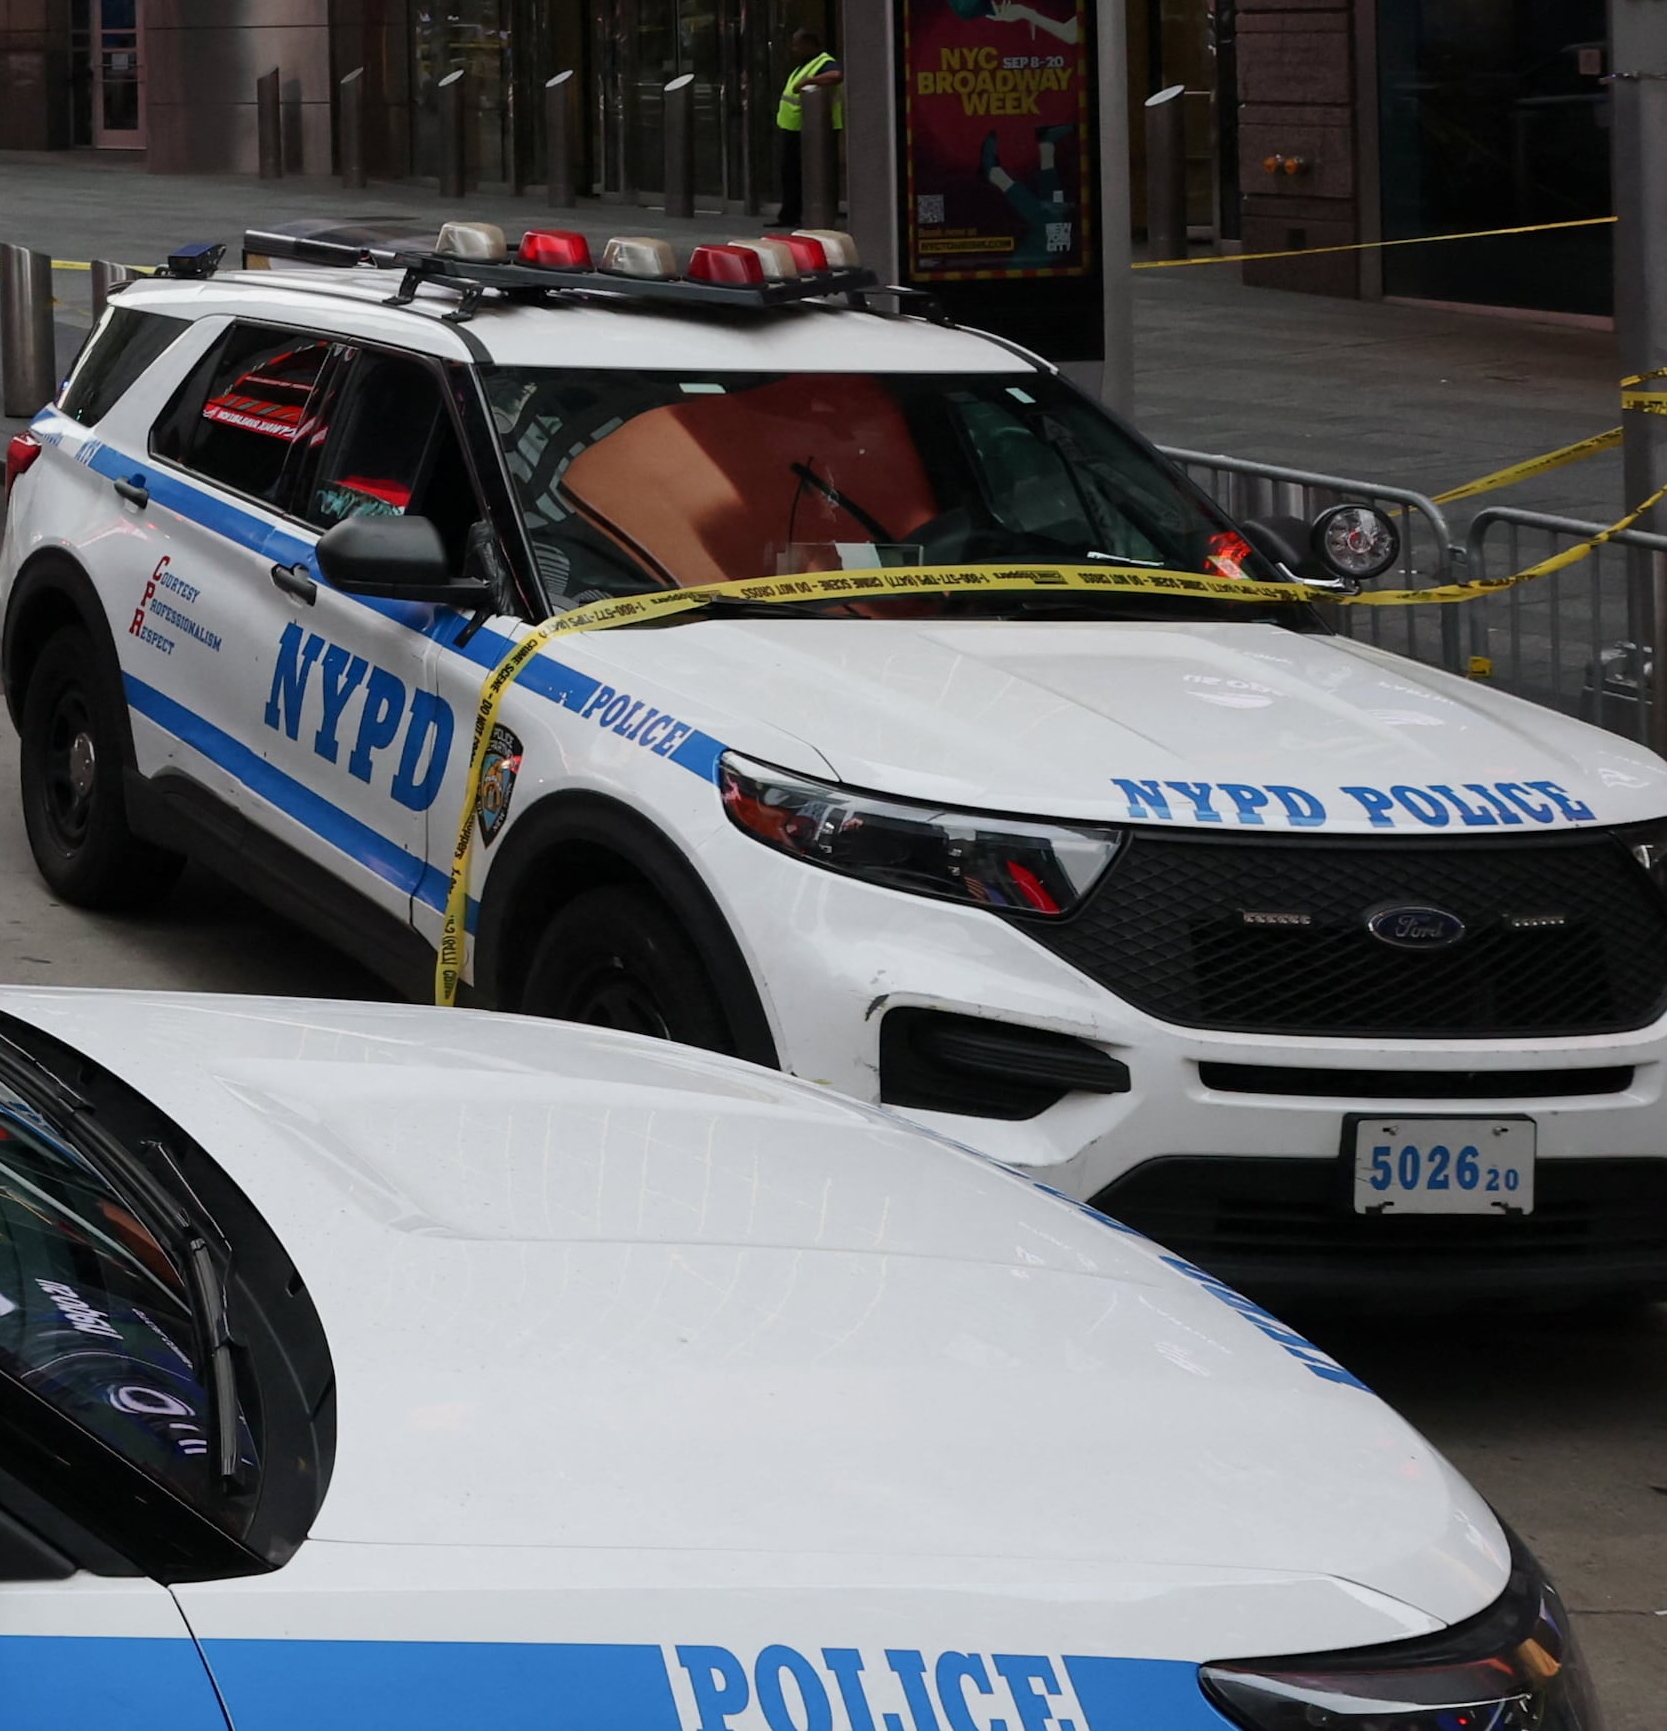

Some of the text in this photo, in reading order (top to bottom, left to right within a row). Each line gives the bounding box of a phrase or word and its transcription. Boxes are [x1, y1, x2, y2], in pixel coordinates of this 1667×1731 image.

[939, 47, 1064, 71] NYC SEP 8-20
[918, 69, 1073, 96] BROADWAY
[962, 91, 1041, 116] WEEK
[153, 555, 201, 604] COURTESY
[741, 586, 771, 599] CROSS
[775, 584, 795, 596] NOT
[797, 583, 811, 594] DO
[819, 578, 847, 594] SCENE
[129, 607, 175, 656] RESPECT
[140, 580, 222, 652] PROFESSIONALISM
[515, 639, 539, 663] CRIME
[492, 663, 515, 694] SCENE
[264, 620, 454, 813] NYPD
[582, 682, 688, 759] POLICE
[1111, 777, 1597, 828] NYPD POLICE
[1370, 1145, 1520, 1192] 5026 20
[671, 1643, 1081, 1731] POLICE
